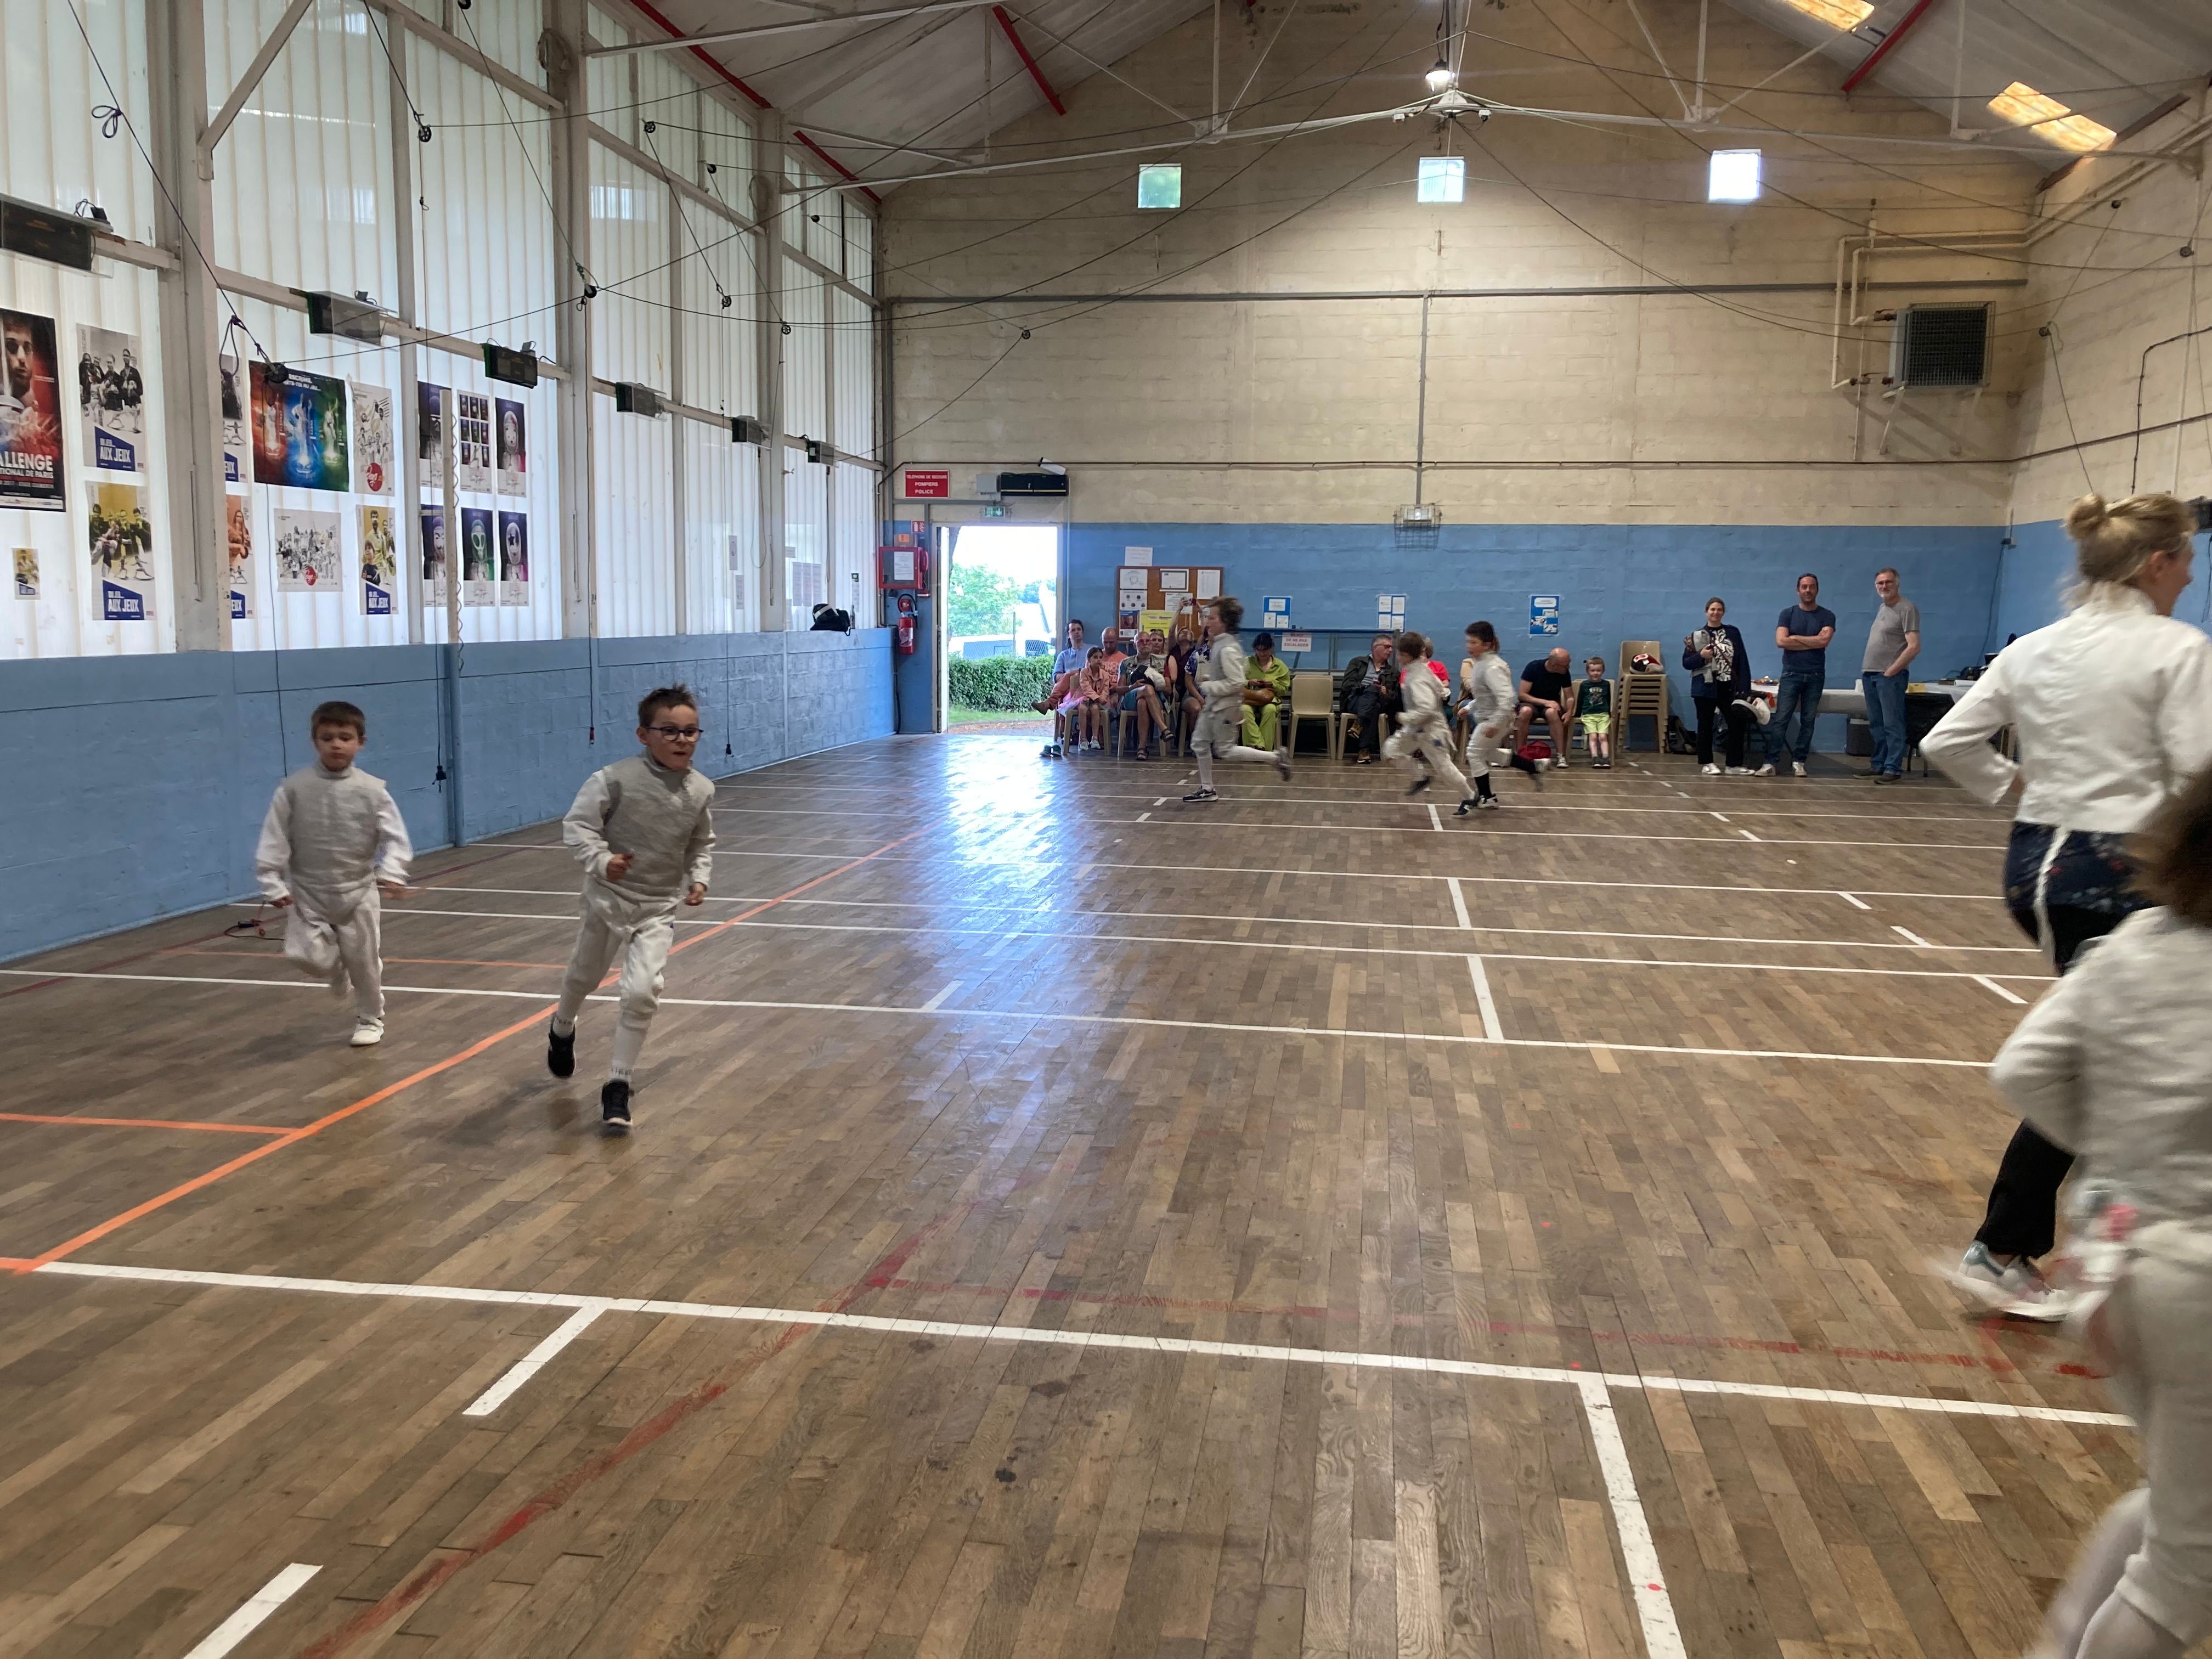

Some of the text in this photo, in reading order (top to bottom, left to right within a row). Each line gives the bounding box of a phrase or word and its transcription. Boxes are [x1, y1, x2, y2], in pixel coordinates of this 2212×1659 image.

[100, 446, 131, 463] AUX JEUX
[108, 599, 140, 612] AUX JEUX
